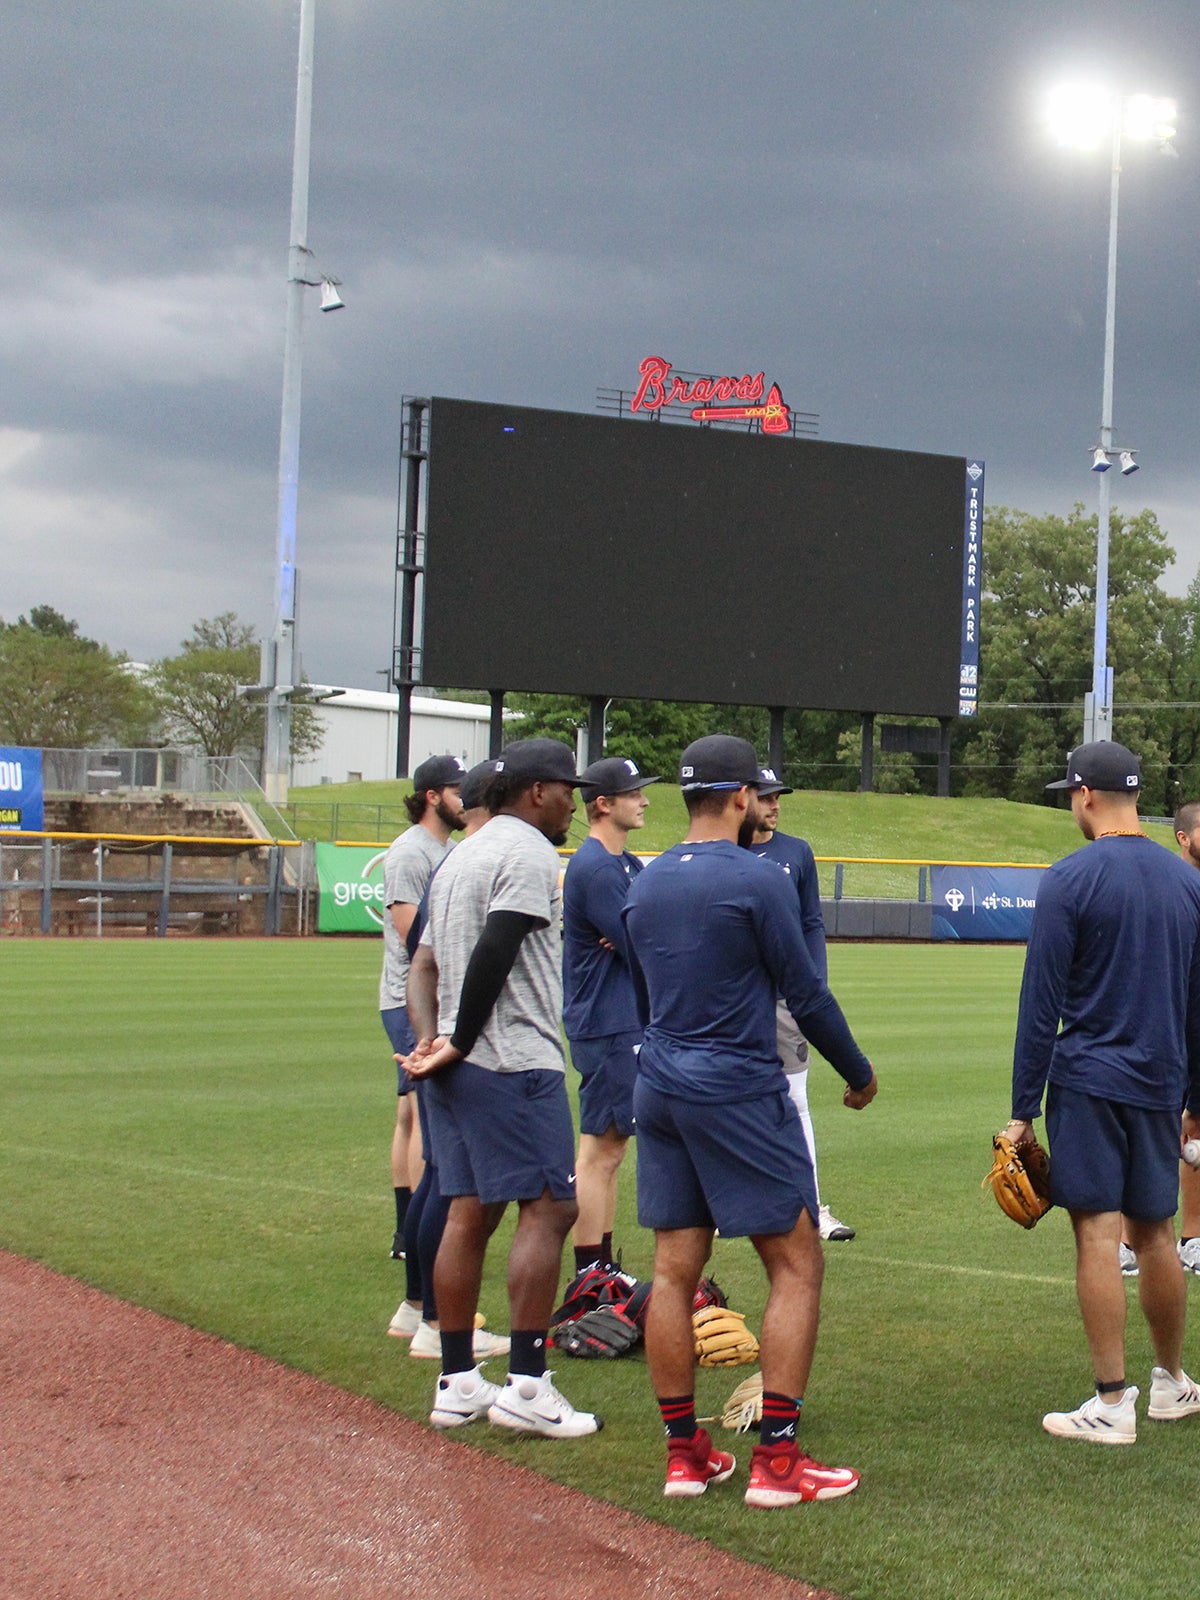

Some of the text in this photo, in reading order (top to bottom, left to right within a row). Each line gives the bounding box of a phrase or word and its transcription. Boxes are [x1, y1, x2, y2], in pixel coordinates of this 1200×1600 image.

[631, 356, 765, 412] Braves
[966, 487, 978, 642] TRUSTMARK PARK
[1001, 896, 1014, 908] St.
